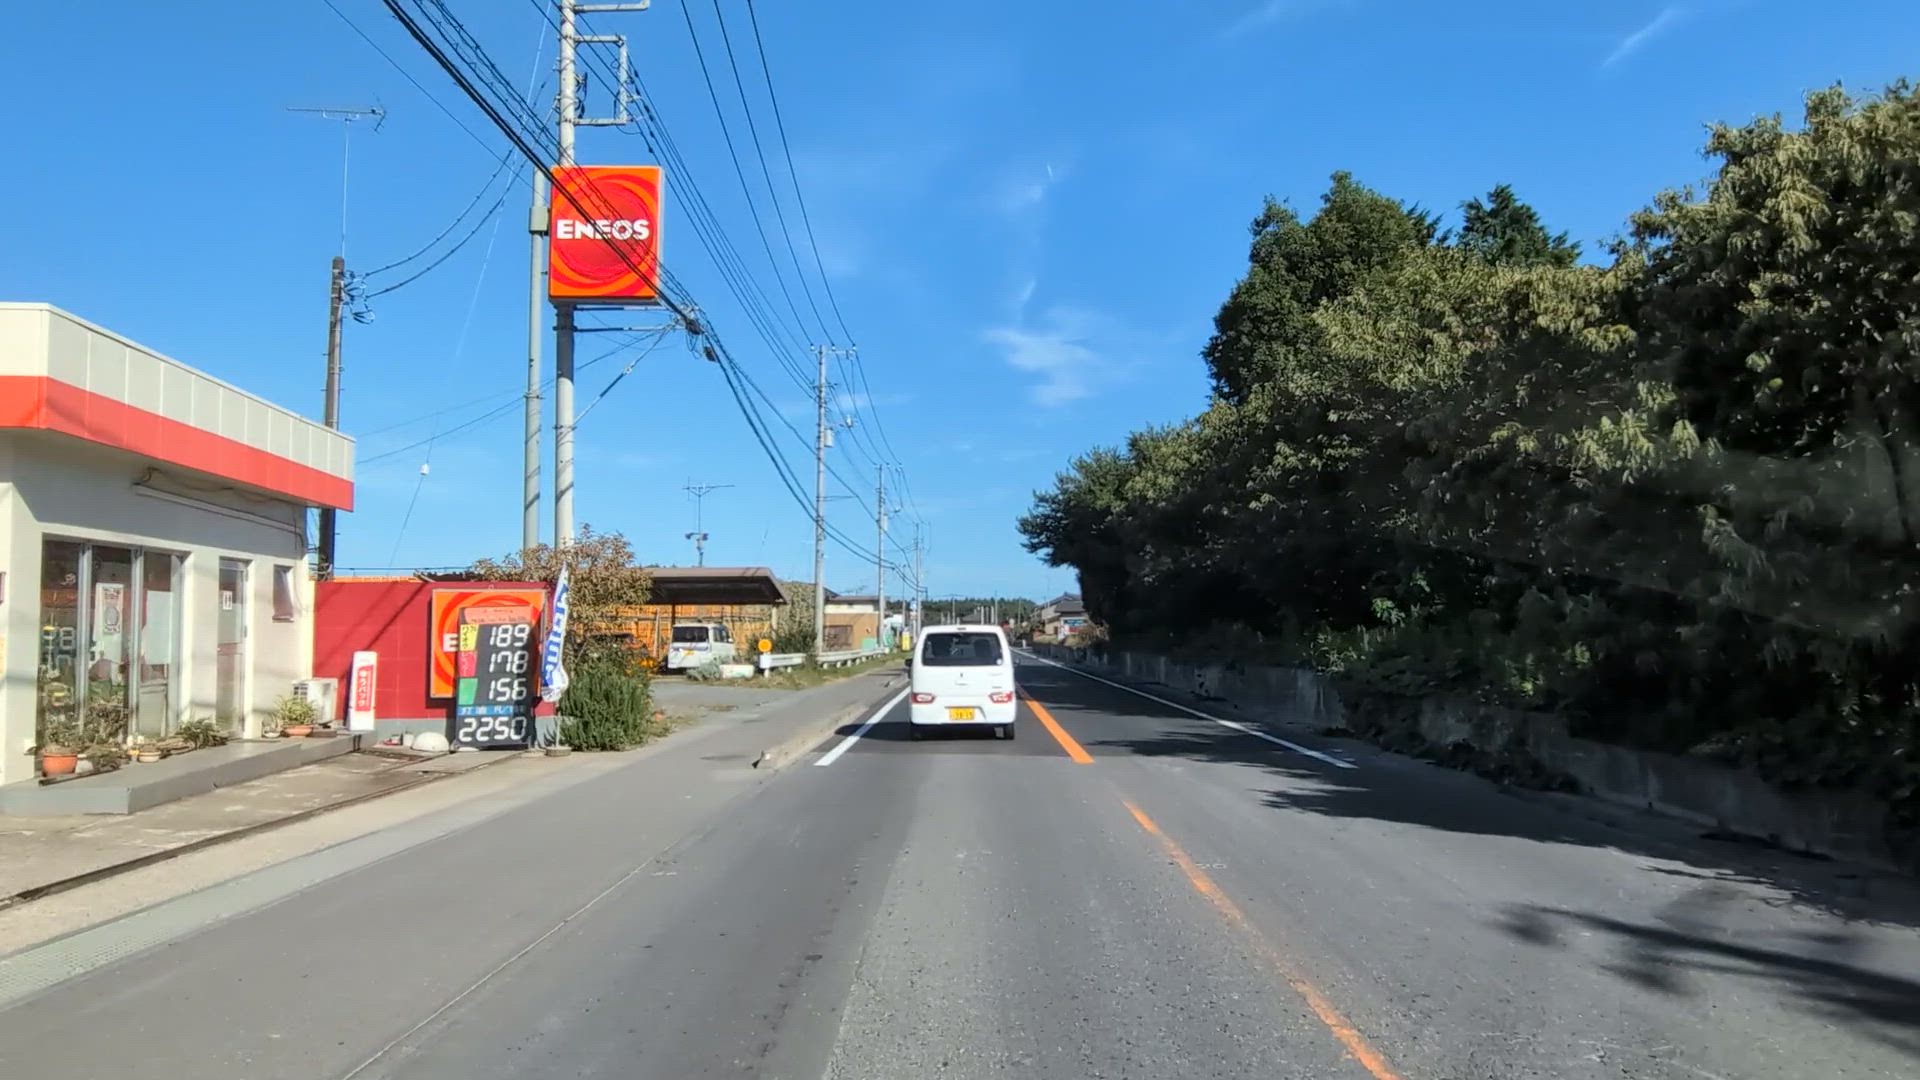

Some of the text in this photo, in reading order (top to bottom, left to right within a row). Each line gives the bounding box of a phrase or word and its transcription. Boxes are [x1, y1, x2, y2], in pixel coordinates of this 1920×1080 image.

[556, 219, 650, 240] ENEOS
[489, 624, 530, 647] 189
[489, 650, 529, 674] 178
[488, 677, 527, 702] 156
[458, 716, 527, 743] 2250
